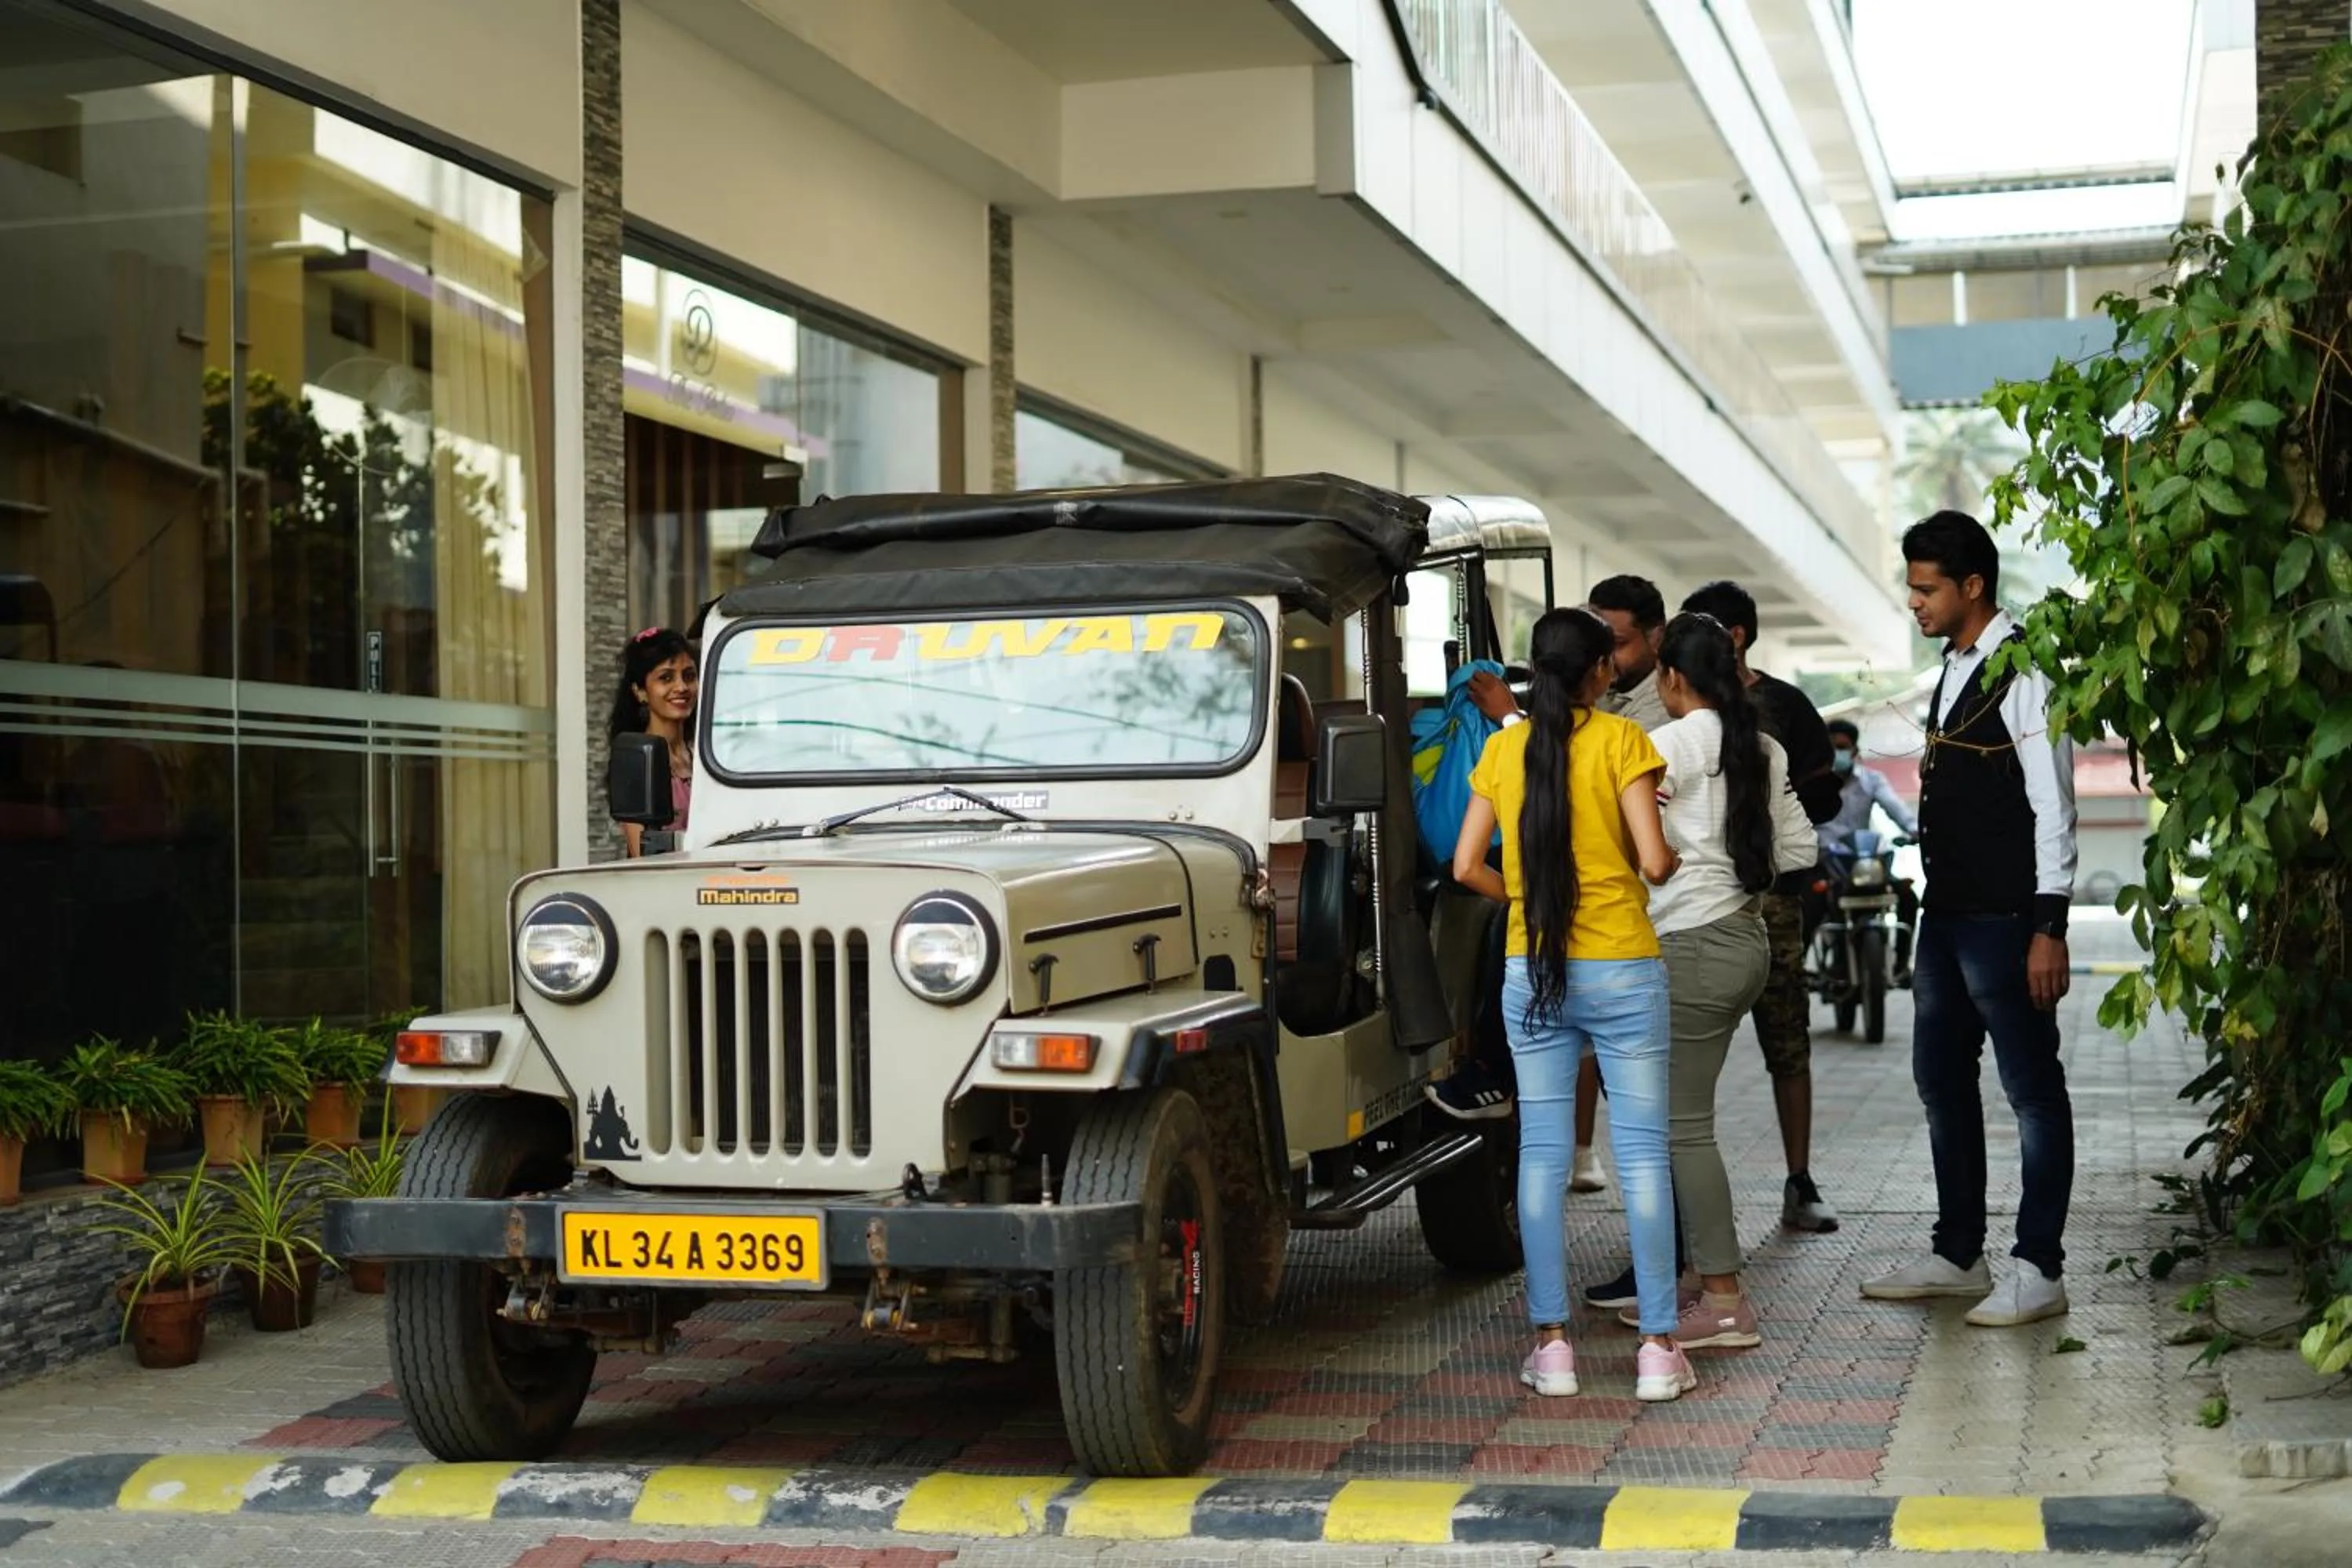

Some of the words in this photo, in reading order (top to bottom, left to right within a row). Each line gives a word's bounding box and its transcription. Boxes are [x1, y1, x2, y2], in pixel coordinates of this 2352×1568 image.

[749, 612, 1225, 664] DRUVAN
[699, 889, 797, 905] Mahindra
[581, 1229, 622, 1268] KL
[633, 1231, 673, 1269] 34
[687, 1232, 704, 1270] A
[716, 1232, 804, 1272] 3369
[1192, 1250, 1202, 1295] RACING
